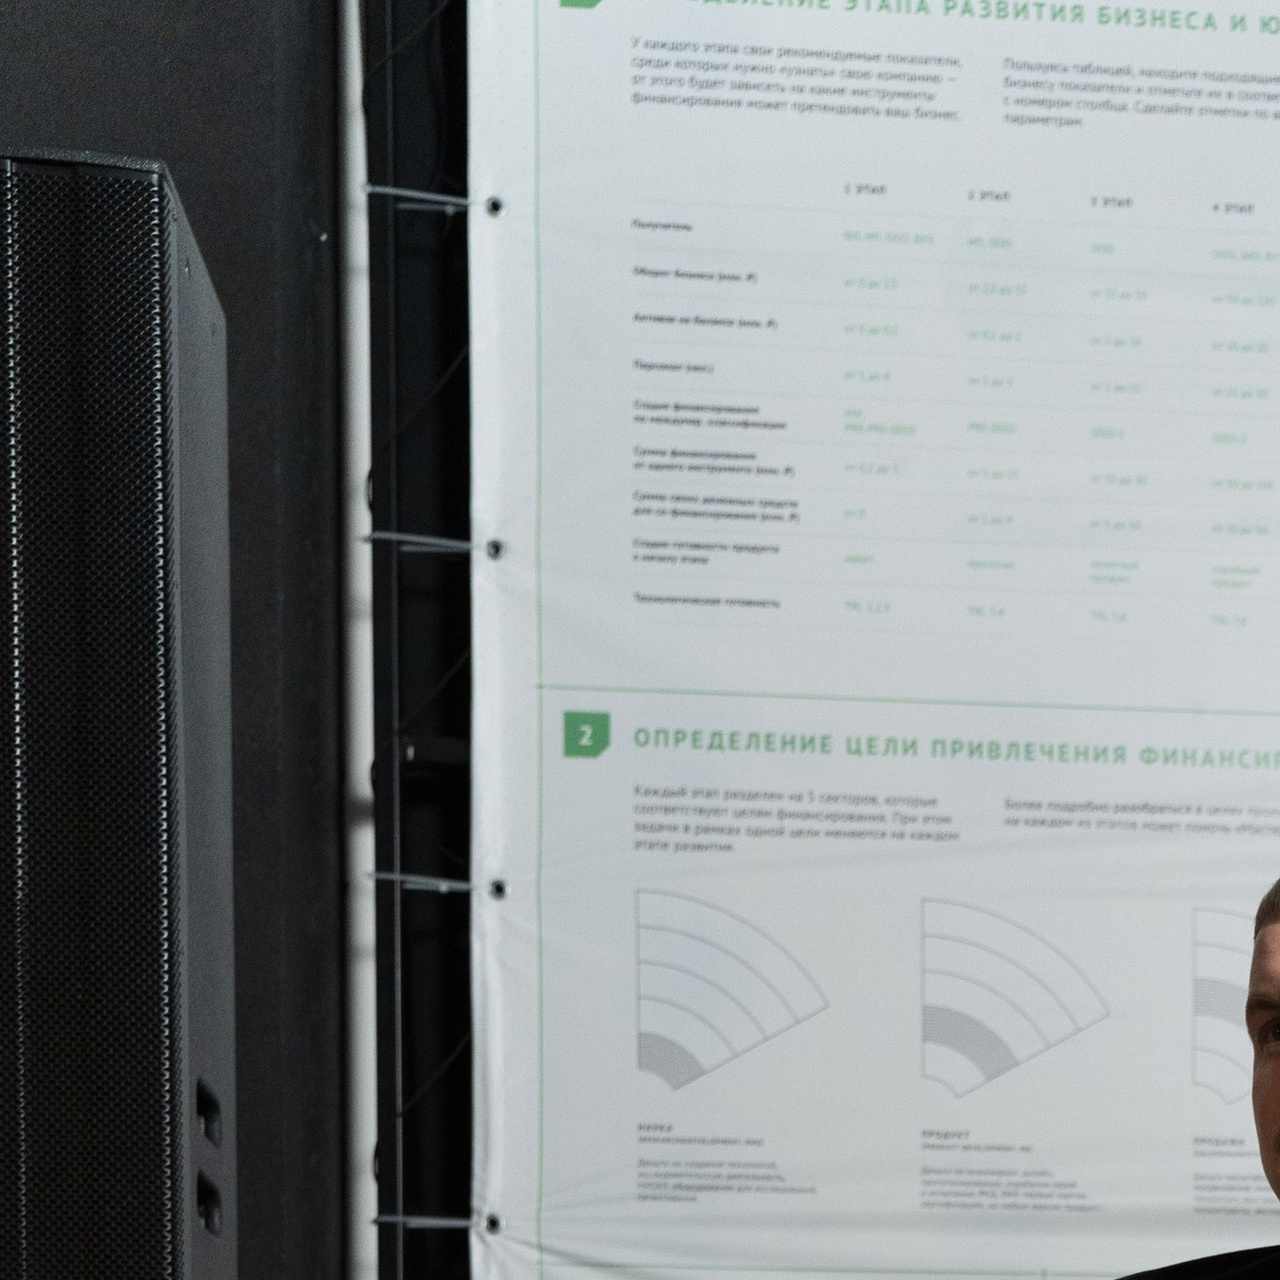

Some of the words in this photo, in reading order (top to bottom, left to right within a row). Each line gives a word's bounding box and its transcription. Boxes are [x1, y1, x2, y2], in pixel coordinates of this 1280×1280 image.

[943, 0, 1086, 22] РАЗВИТИЯ
[1096, 5, 1218, 30] БИЗНЕСА
[1230, 13, 1247, 31] И
[578, 725, 593, 746] 2
[633, 728, 832, 755] ОПРЕДЕЛЕНИЕ
[846, 736, 918, 758] ЦЕЛИ
[930, 738, 1128, 764] ПРИВЛЕЧЕНИЯ
